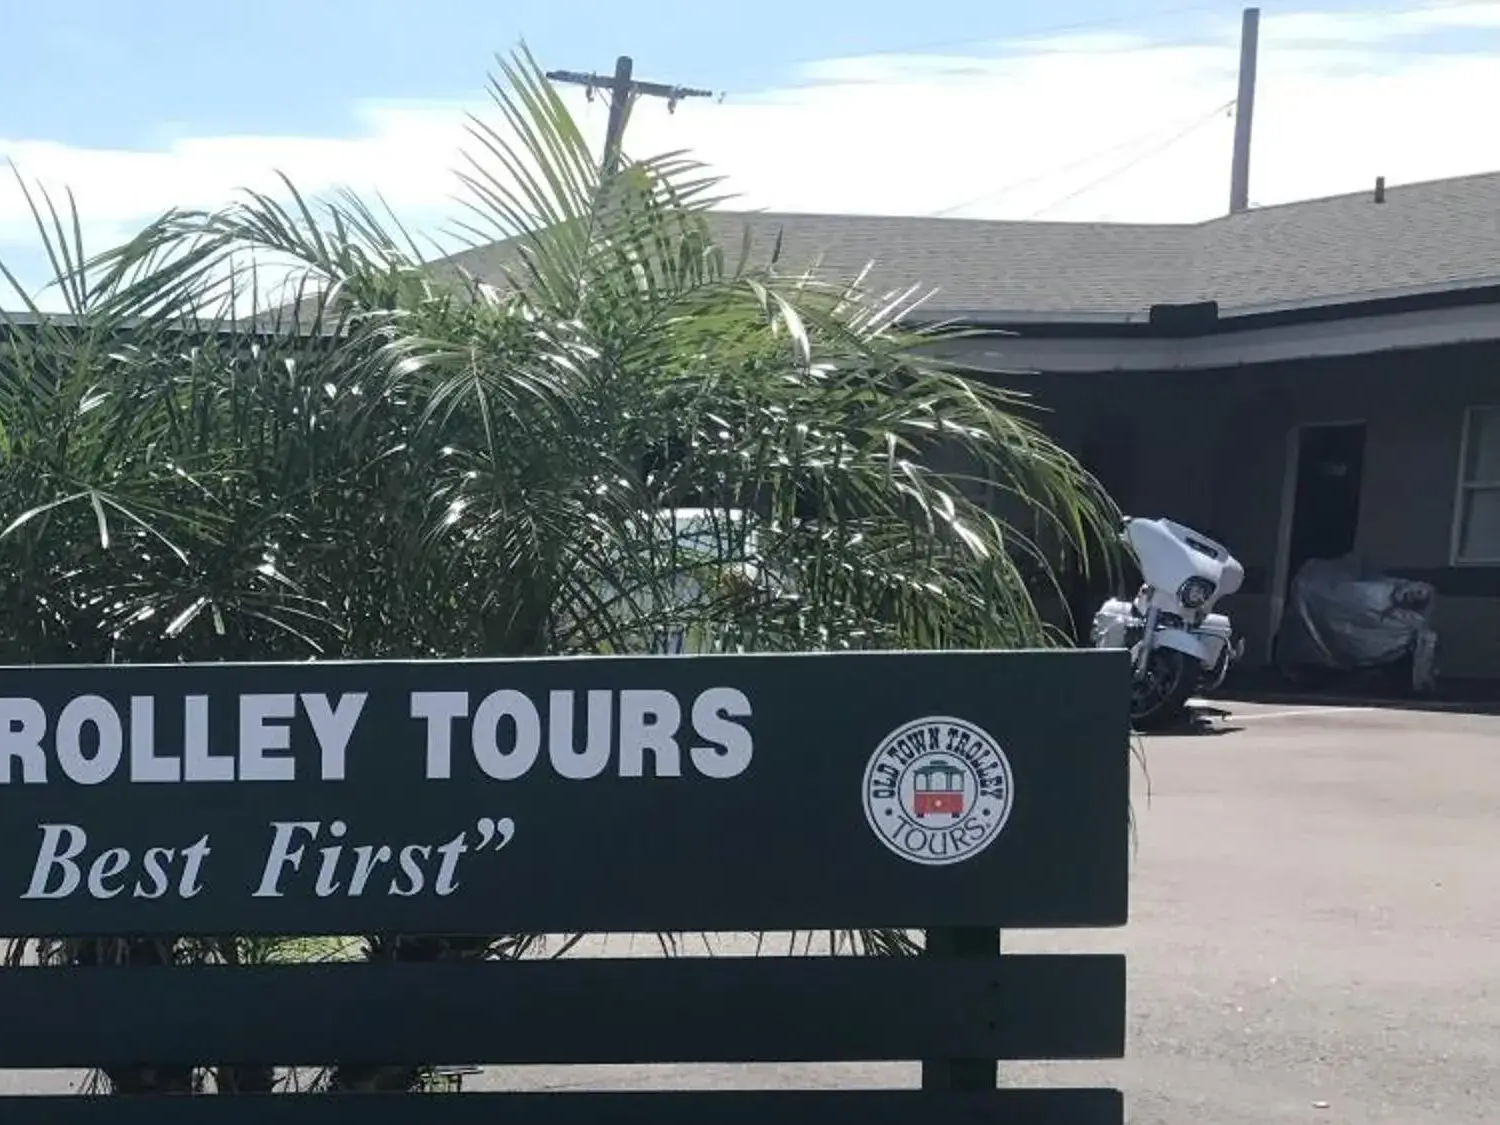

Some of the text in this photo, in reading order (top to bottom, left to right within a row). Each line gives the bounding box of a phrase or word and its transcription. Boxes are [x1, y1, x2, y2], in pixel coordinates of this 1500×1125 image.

[410, 687, 754, 781] TOURS
[872, 727, 1005, 800] OLD TOWN TROLLEY
[19, 822, 211, 899] Best
[251, 816, 516, 897] First”
[891, 815, 986, 855] TOURS
